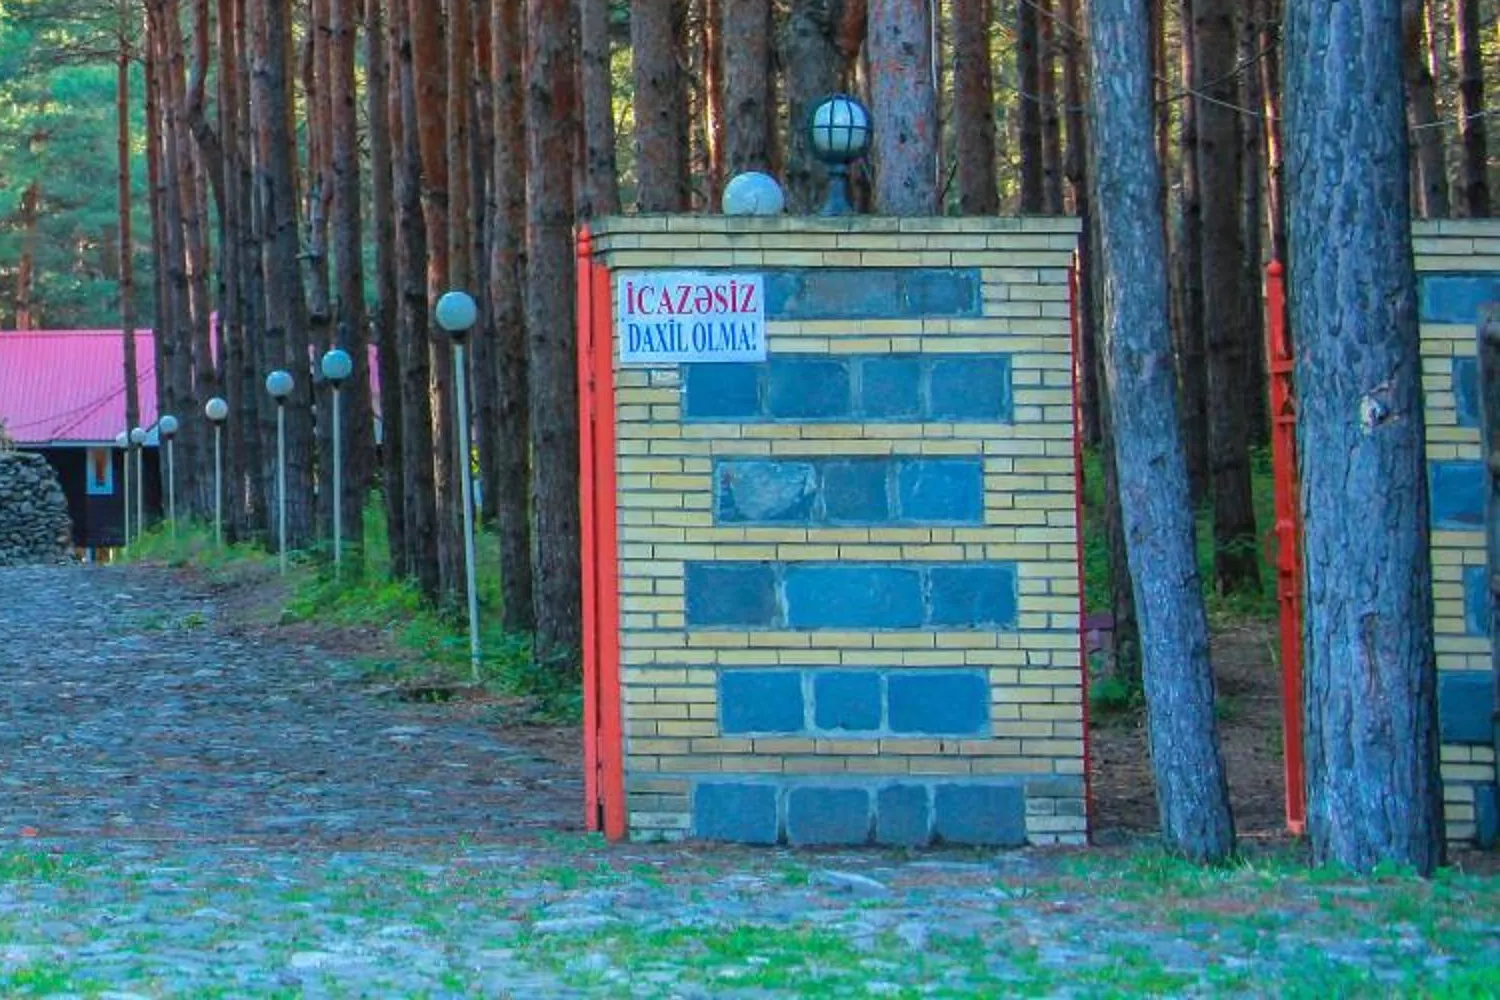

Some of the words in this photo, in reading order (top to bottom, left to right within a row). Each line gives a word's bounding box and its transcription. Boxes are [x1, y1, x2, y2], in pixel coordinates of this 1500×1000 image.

[627, 280, 757, 314] İCAZƏSİZ
[628, 319, 689, 352] DAXİL
[692, 321, 757, 351] OLMA!
